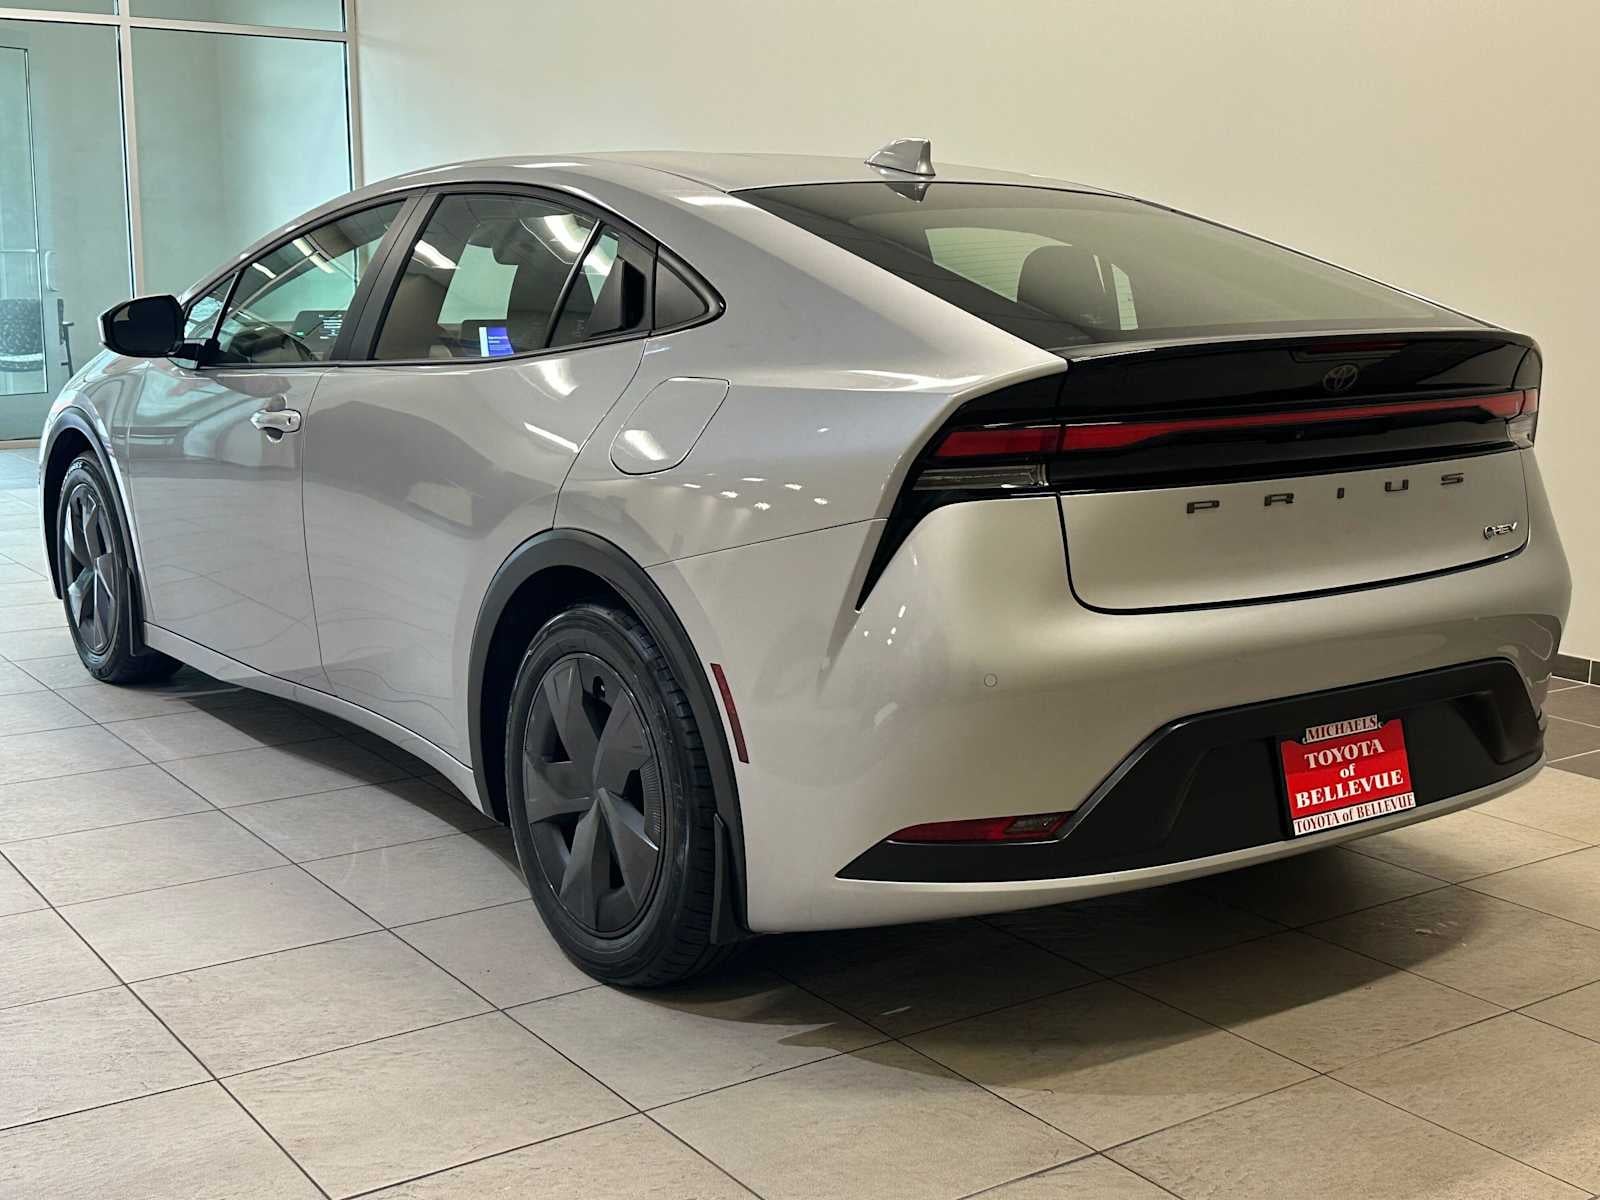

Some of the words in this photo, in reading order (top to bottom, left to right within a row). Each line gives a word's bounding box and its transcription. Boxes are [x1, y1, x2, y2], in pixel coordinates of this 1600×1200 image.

[1186, 472, 1464, 514] PRIUS
[1307, 716, 1377, 741] MICHAELS
[1304, 739, 1385, 769] TOYOTA
[1339, 763, 1356, 778] of
[1295, 769, 1404, 809] BELLEVUE
[1294, 811, 1341, 833] TOYOTA
[1342, 810, 1354, 822] of
[1357, 794, 1415, 818] BELLEVUE
